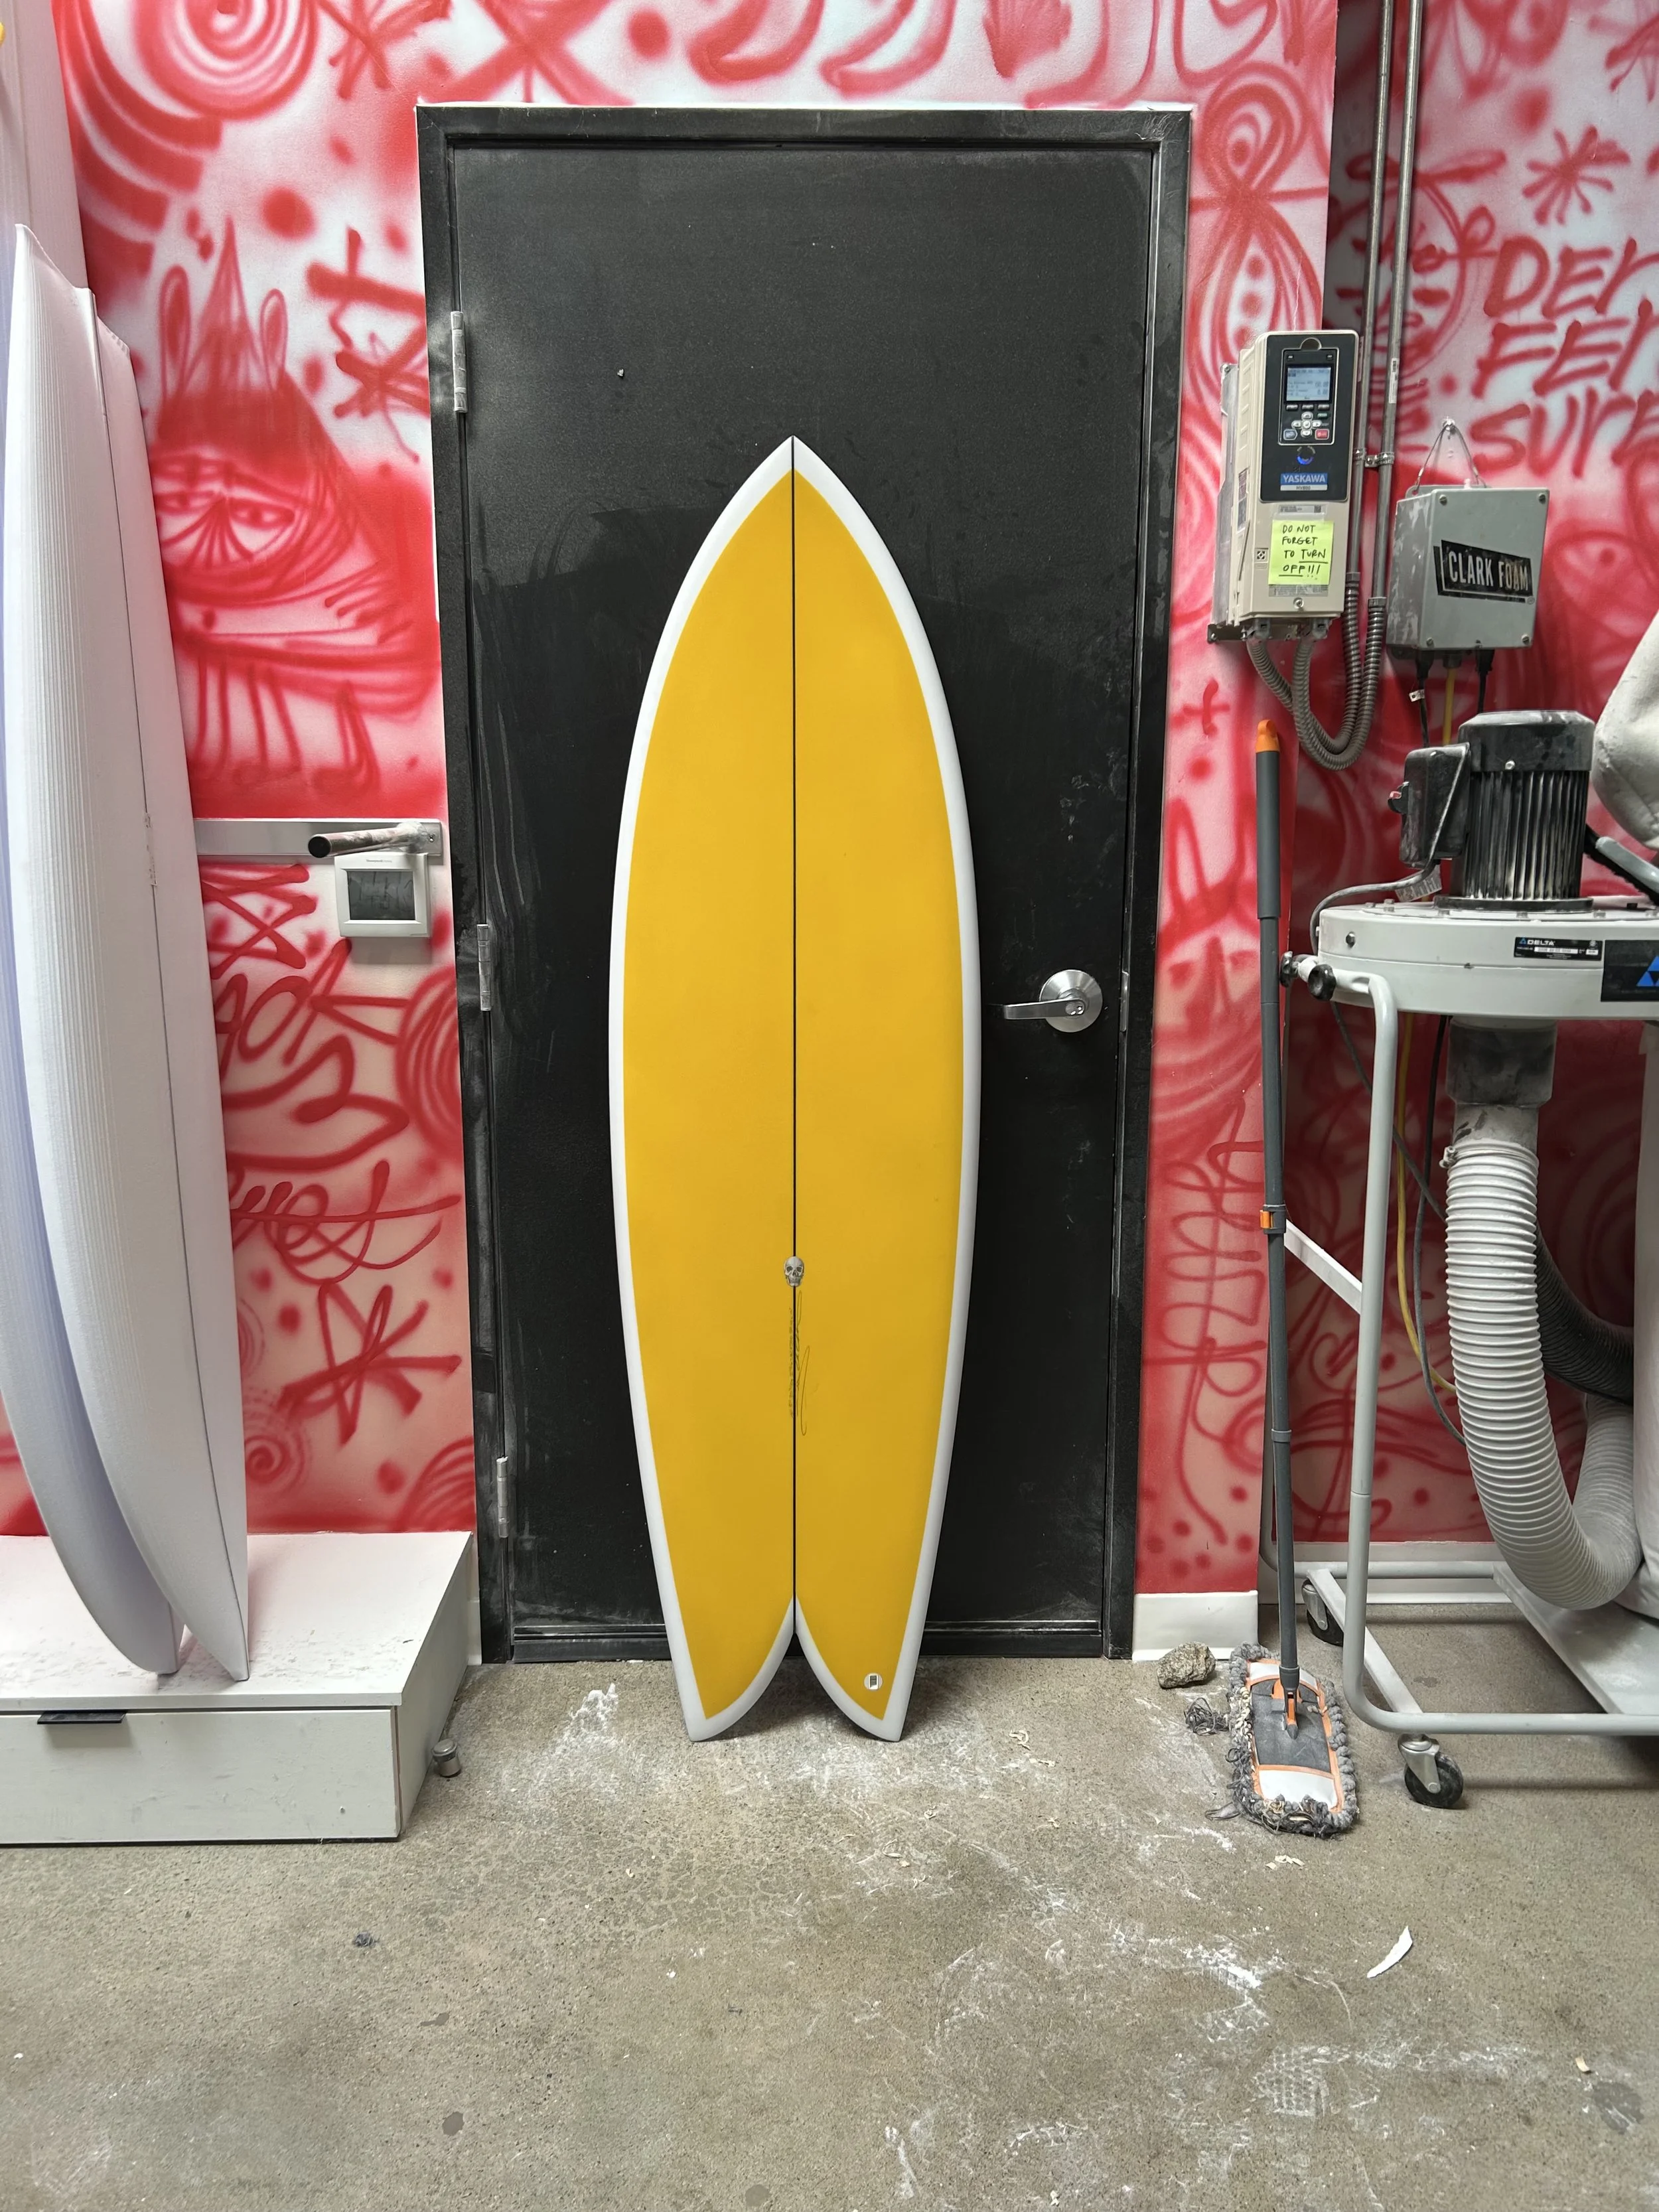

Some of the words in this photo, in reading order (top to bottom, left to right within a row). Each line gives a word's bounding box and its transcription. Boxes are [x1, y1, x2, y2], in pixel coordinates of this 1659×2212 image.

[1283, 475, 1326, 483] YASKAWA
[1283, 524, 1293, 534] DO
[1297, 524, 1316, 533] NOT
[1282, 536, 1318, 546] FORGET
[1284, 550, 1295, 559] TO
[1301, 548, 1326, 559] TURN
[1283, 564, 1321, 580] OFF!!!
[1449, 551, 1493, 587] CLARK
[1498, 561, 1528, 591] FOAM
